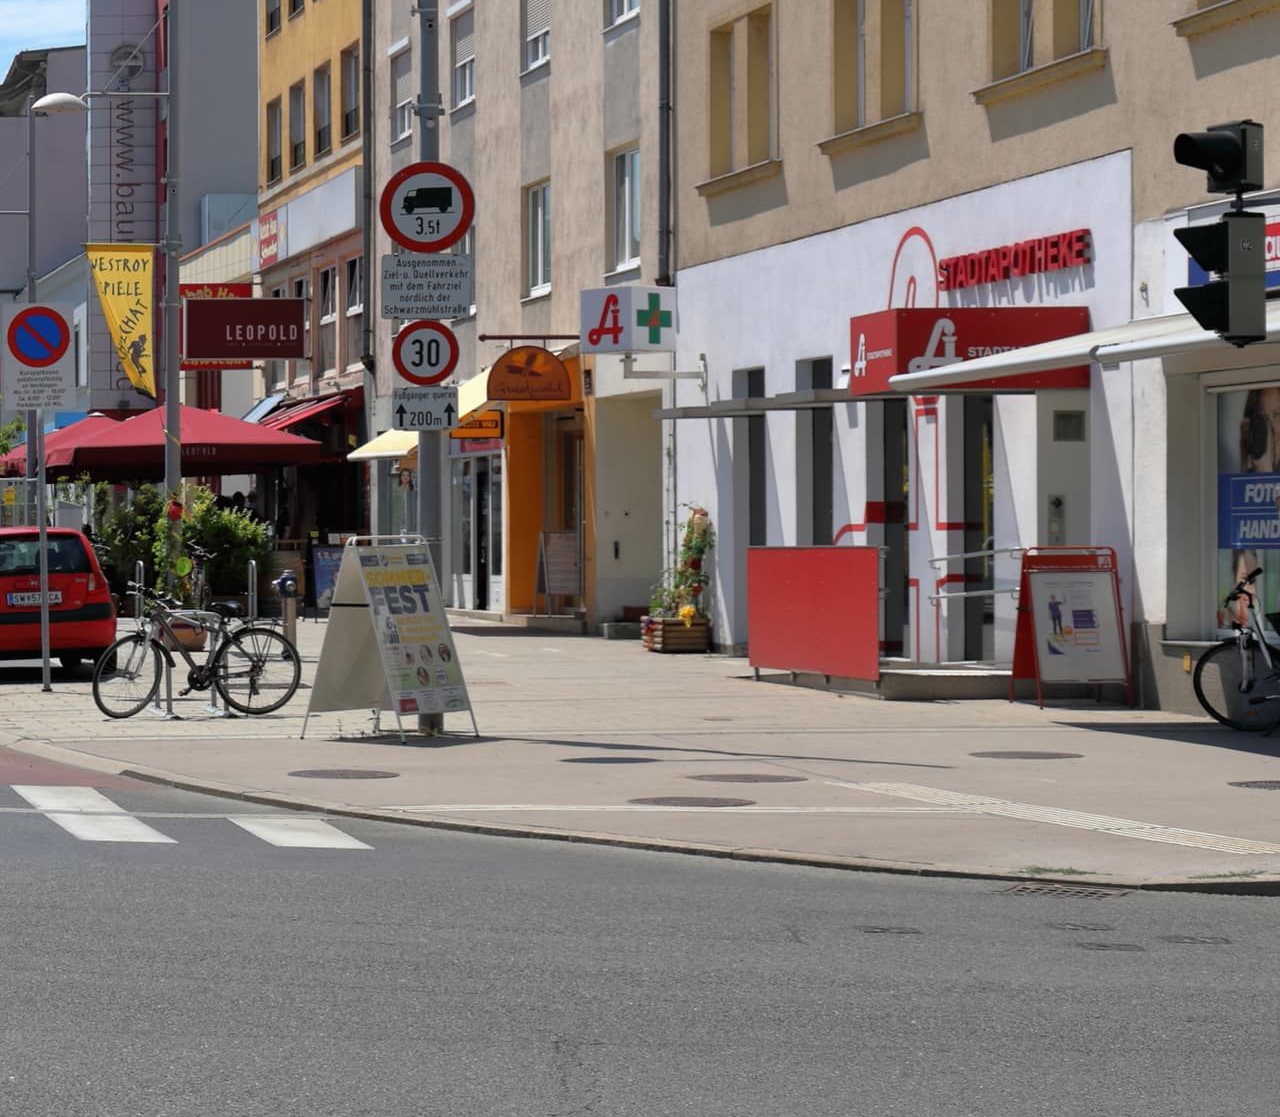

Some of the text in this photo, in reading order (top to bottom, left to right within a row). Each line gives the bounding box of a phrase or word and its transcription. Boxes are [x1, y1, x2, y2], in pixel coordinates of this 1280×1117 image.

[397, 258, 457, 270] Ausgenommen
[938, 229, 1091, 291] STADTAPOTHEKE
[413, 269, 469, 279] Quellverkehr
[100, 281, 143, 296] PIELE
[390, 280, 462, 291] mit dem Fahrziel
[399, 292, 451, 302] nördlich der
[226, 325, 297, 341] LEOPOLD
[411, 338, 440, 367] 30
[369, 584, 430, 615] FEST
